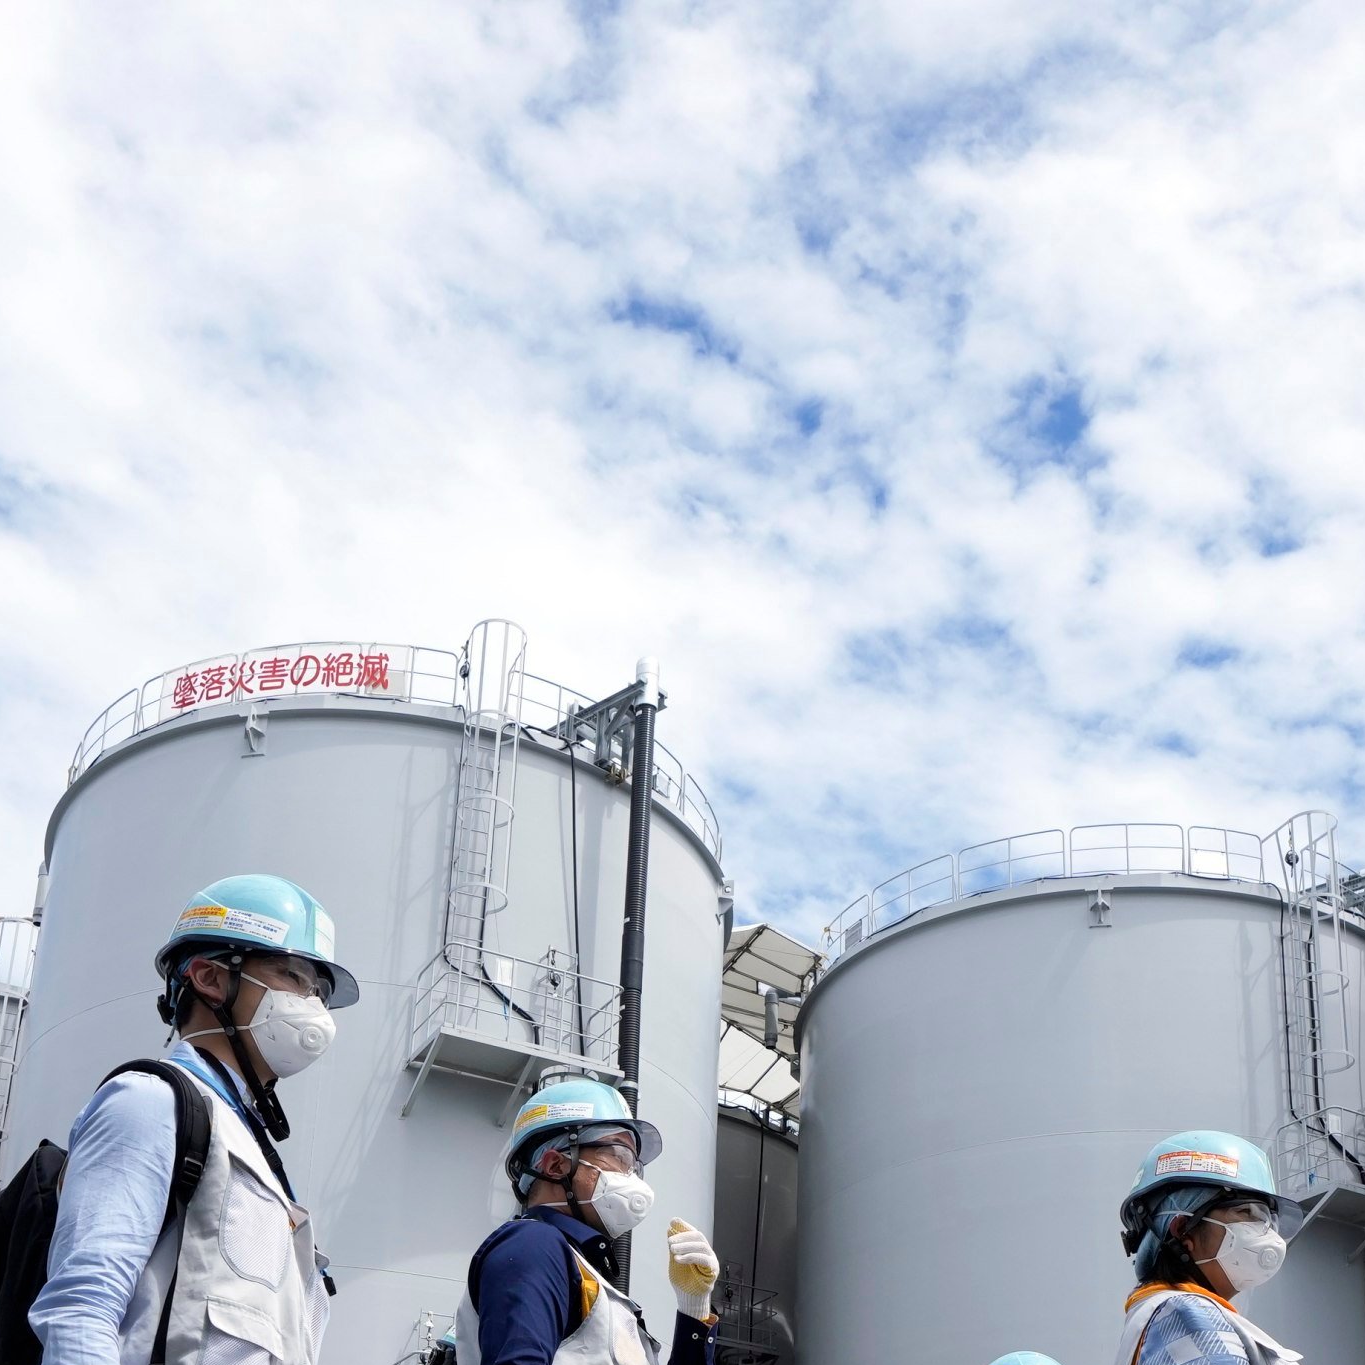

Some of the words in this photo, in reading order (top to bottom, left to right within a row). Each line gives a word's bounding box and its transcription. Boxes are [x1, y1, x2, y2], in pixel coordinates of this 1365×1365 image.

[171, 652, 389, 709] 墜落災害の絶滅
